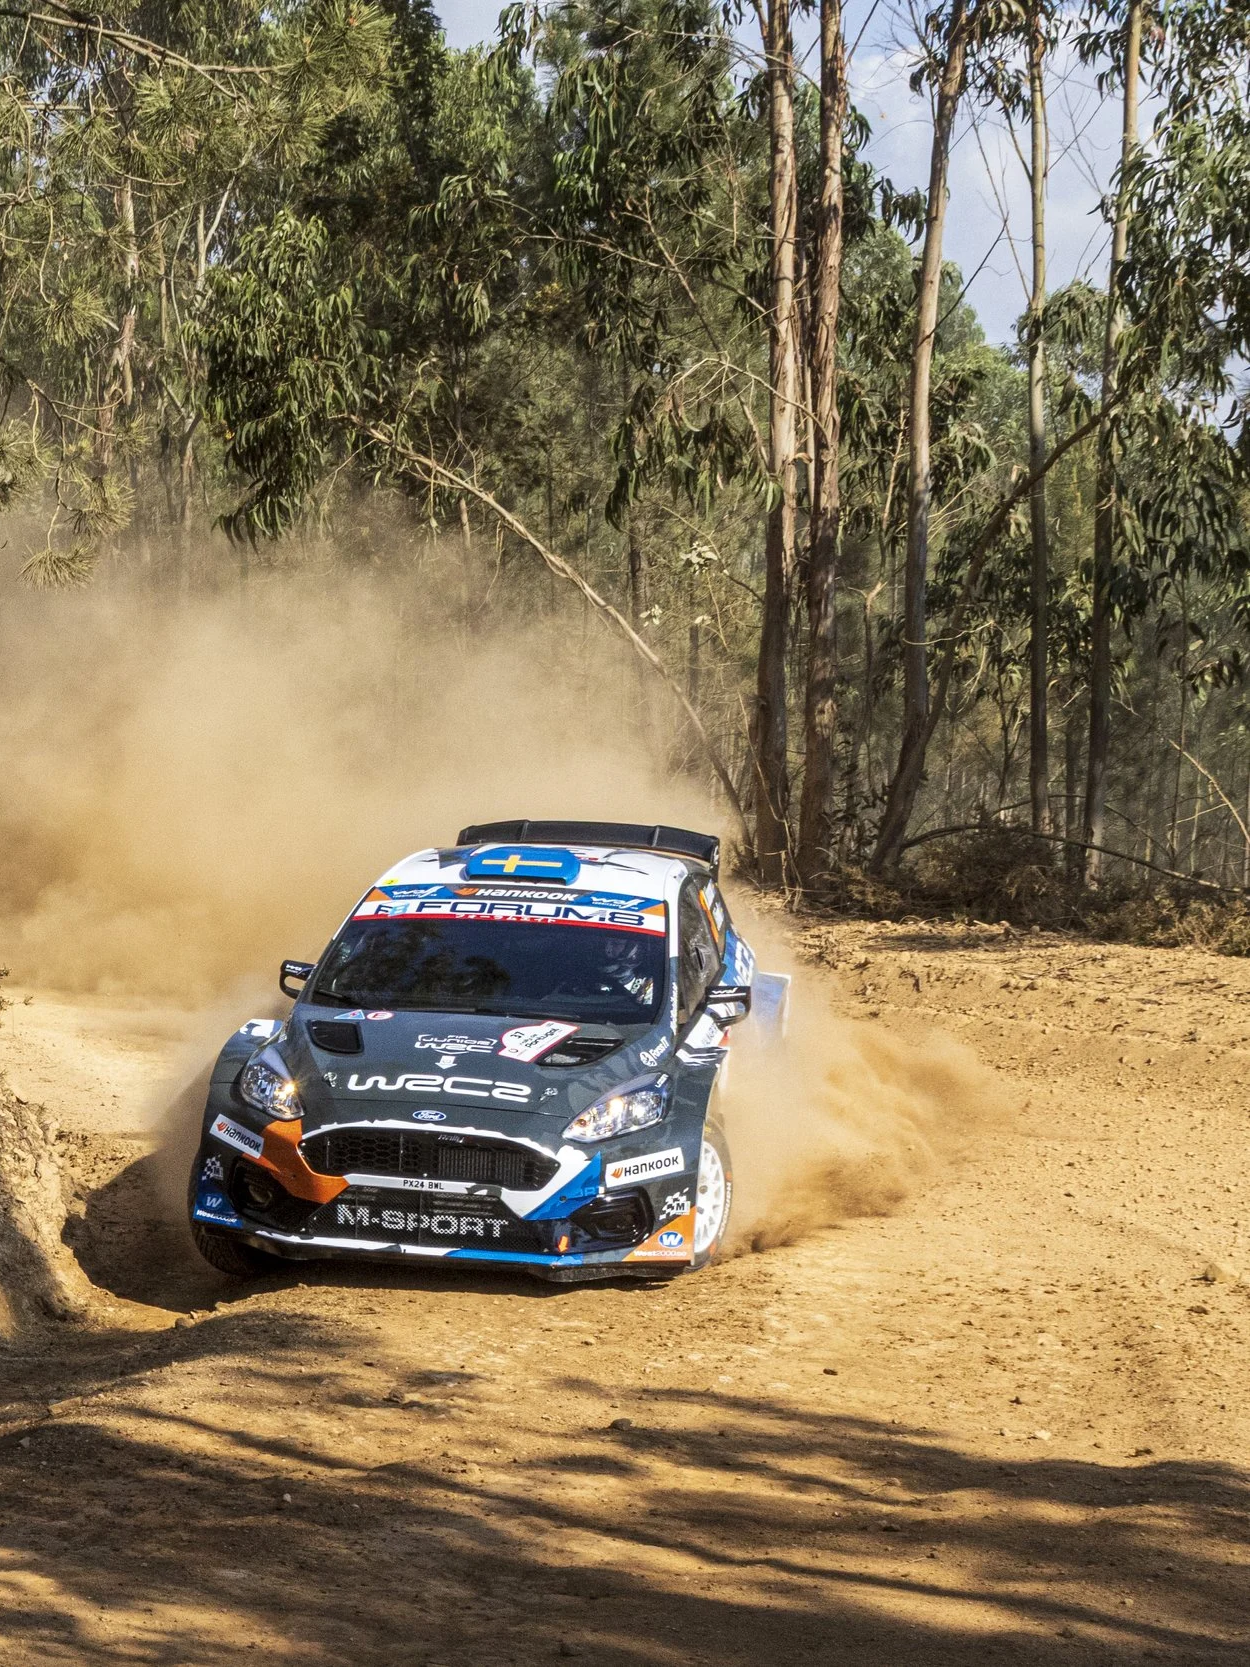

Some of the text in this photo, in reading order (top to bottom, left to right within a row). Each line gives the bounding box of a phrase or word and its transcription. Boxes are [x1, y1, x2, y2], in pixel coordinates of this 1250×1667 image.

[415, 901, 645, 926] FORUM8
[510, 1031, 525, 1039] 37
[525, 1027, 560, 1049] Portugal
[416, 1111, 441, 1121] Ford
[403, 1179, 444, 1190] PX24 BWL
[205, 1196, 222, 1208] W
[675, 1202, 685, 1211] M
[661, 1234, 683, 1247] W
